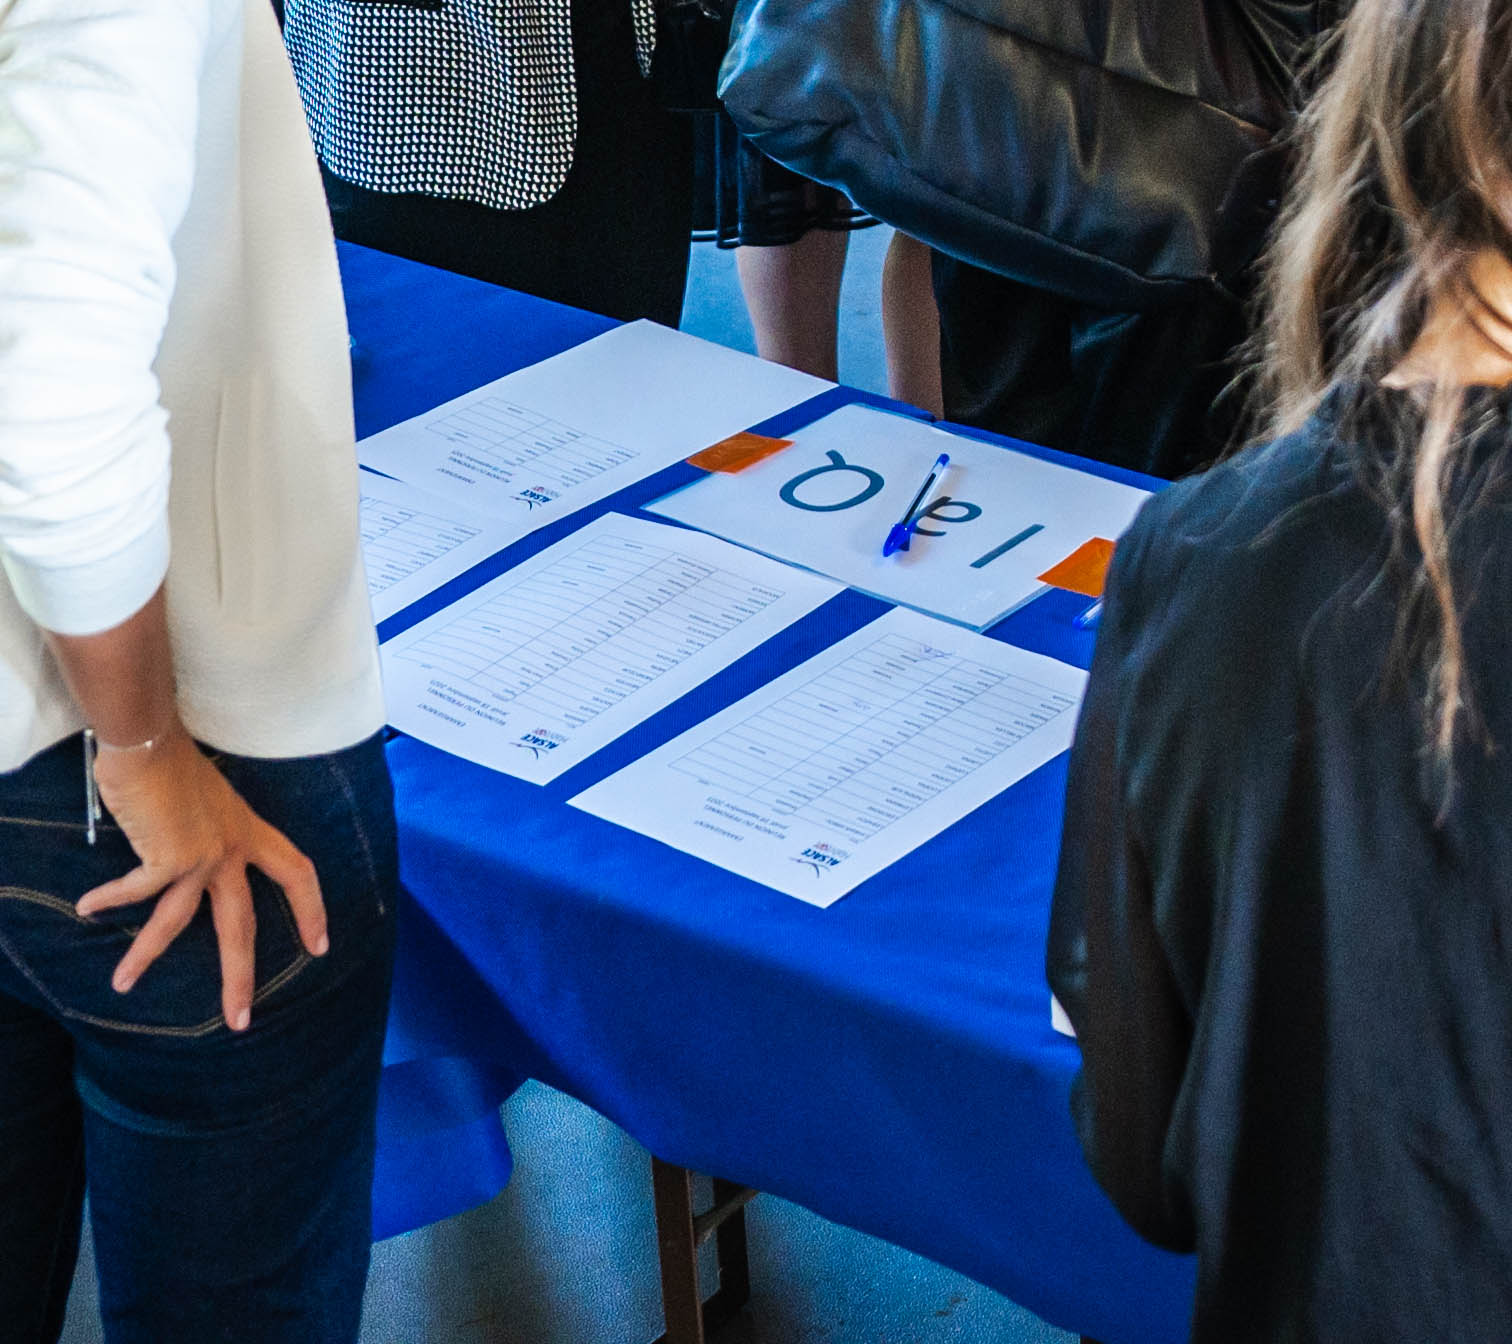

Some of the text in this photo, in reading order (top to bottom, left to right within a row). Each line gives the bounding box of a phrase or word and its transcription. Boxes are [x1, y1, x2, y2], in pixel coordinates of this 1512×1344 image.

[779, 449, 885, 512] Q
[520, 734, 558, 748] ALSACE
[801, 849, 840, 865] ALSACE
